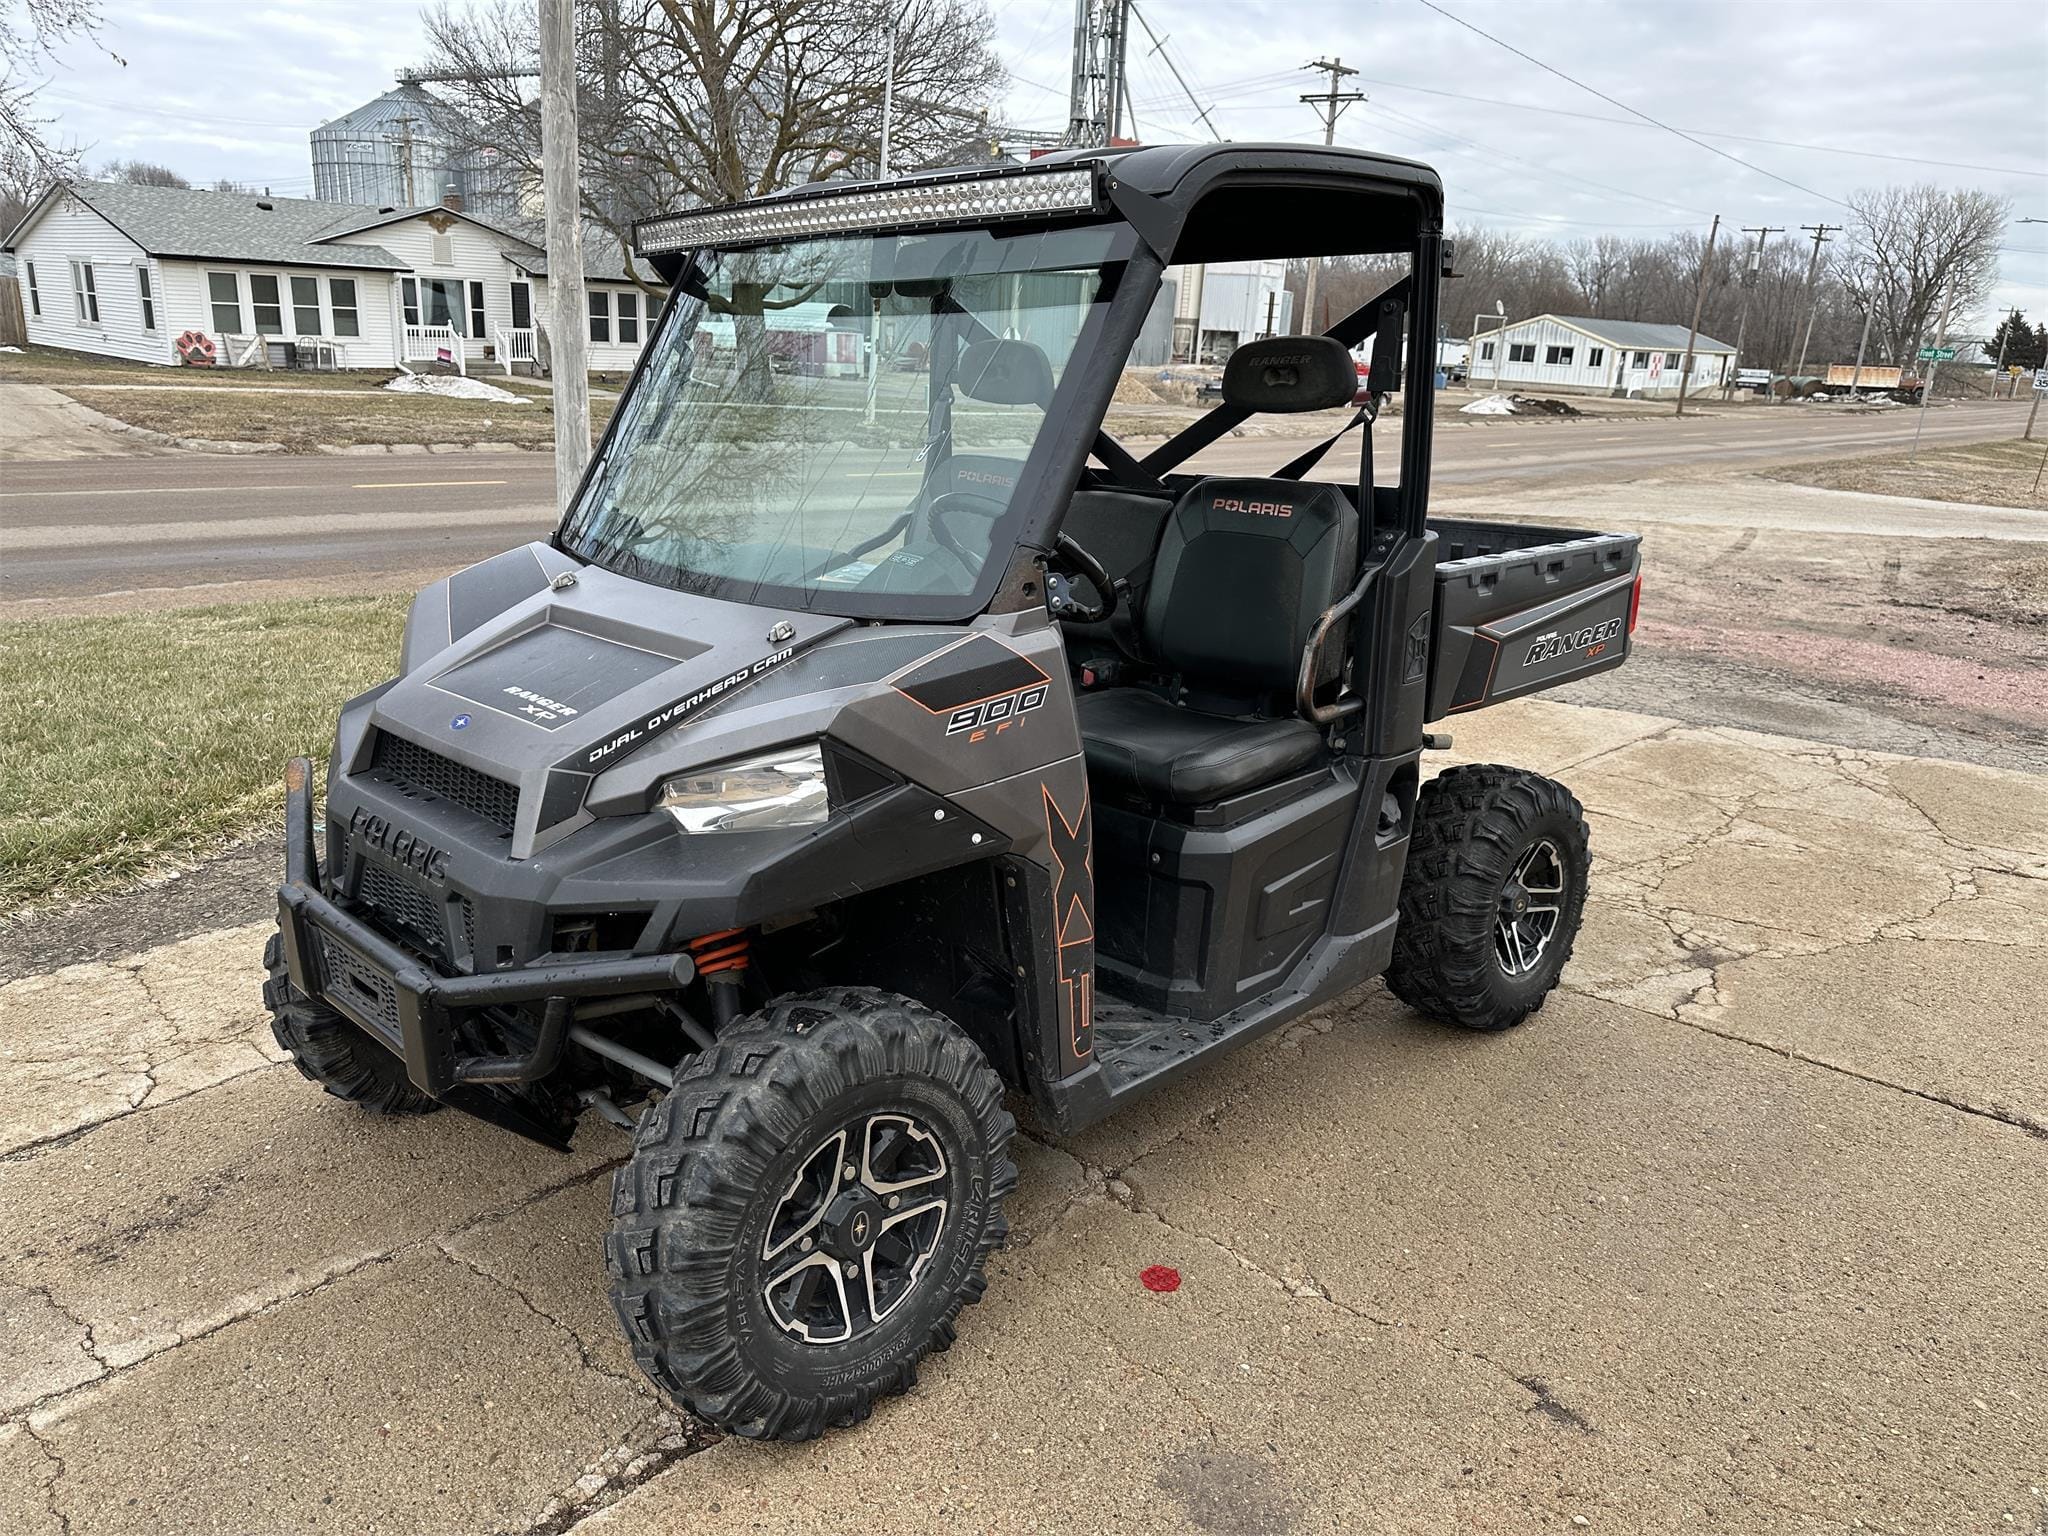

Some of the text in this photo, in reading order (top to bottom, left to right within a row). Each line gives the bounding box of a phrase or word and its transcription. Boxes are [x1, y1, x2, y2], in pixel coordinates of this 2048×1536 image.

[1250, 354, 1313, 366] RANGER
[1920, 349, 1954, 359] Front Street
[2034, 379, 2048, 388] 35
[958, 470, 1015, 488] POLARIS
[1212, 498, 1294, 518] POLARIS
[1523, 617, 1622, 667] RANGER
[1535, 631, 1558, 643] POLARIS
[1584, 643, 1607, 659] XP
[503, 686, 578, 716] RANGER
[589, 647, 793, 763] DUAL OVERHEAD CAM
[518, 704, 557, 720] XP
[946, 684, 1050, 737] 900
[350, 806, 453, 888] POLARIS
